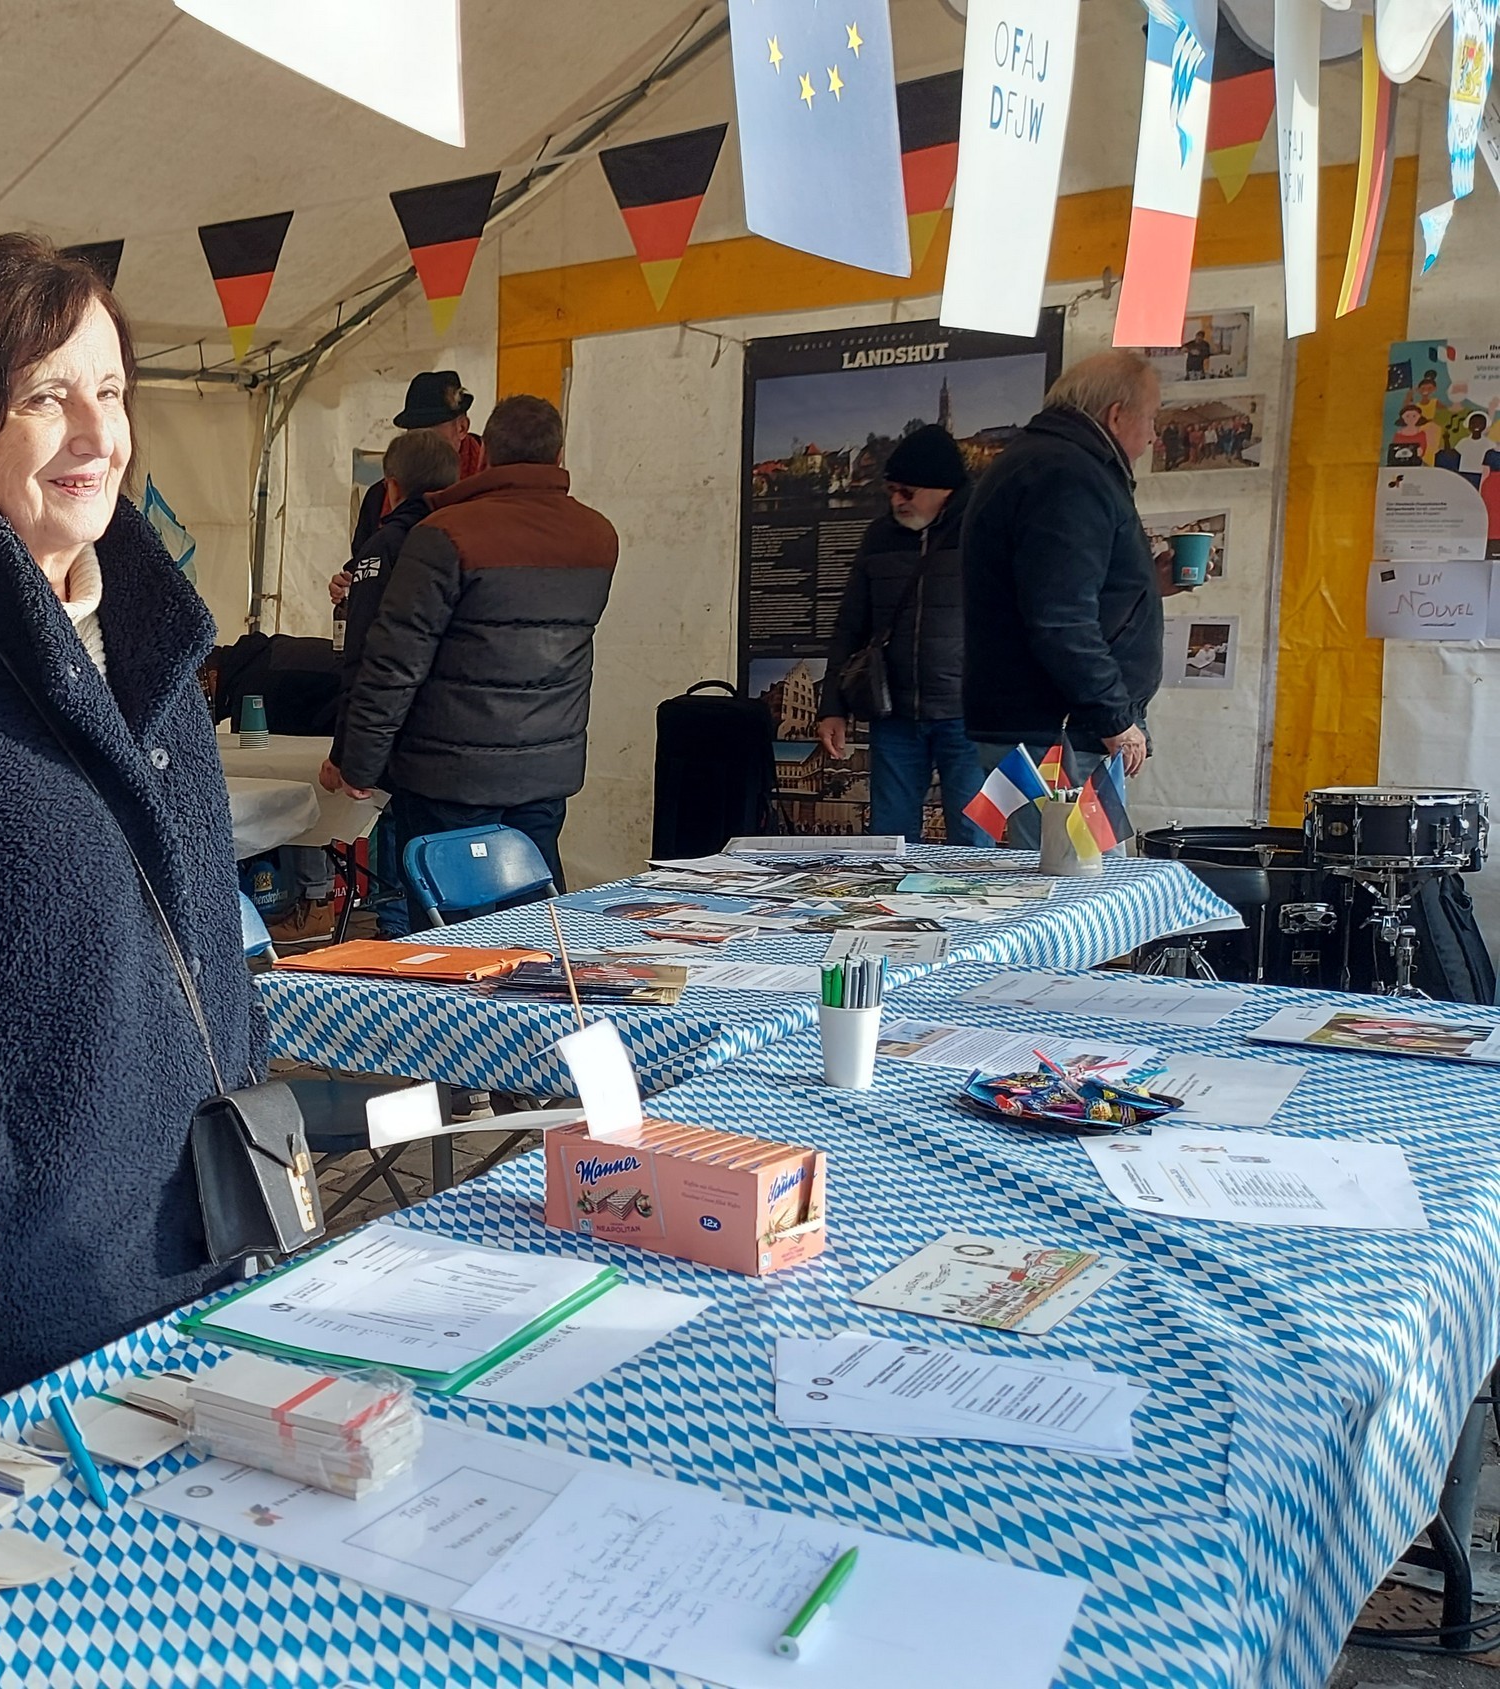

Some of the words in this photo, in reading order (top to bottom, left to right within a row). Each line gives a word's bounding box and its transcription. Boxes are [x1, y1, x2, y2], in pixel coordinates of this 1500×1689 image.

[994, 20, 1049, 83] OFAJ
[989, 84, 1045, 144] DFJW
[841, 341, 950, 370] LANDSHUT
[1388, 590, 1474, 619] NOUVEL
[575, 1155, 642, 1186] Manner
[596, 1224, 642, 1234] NEAPOLITAN
[702, 1217, 719, 1229] 12x
[475, 1359, 525, 1388] Bouteille
[518, 1351, 538, 1362] de
[399, 1494, 441, 1520] Tarifs
